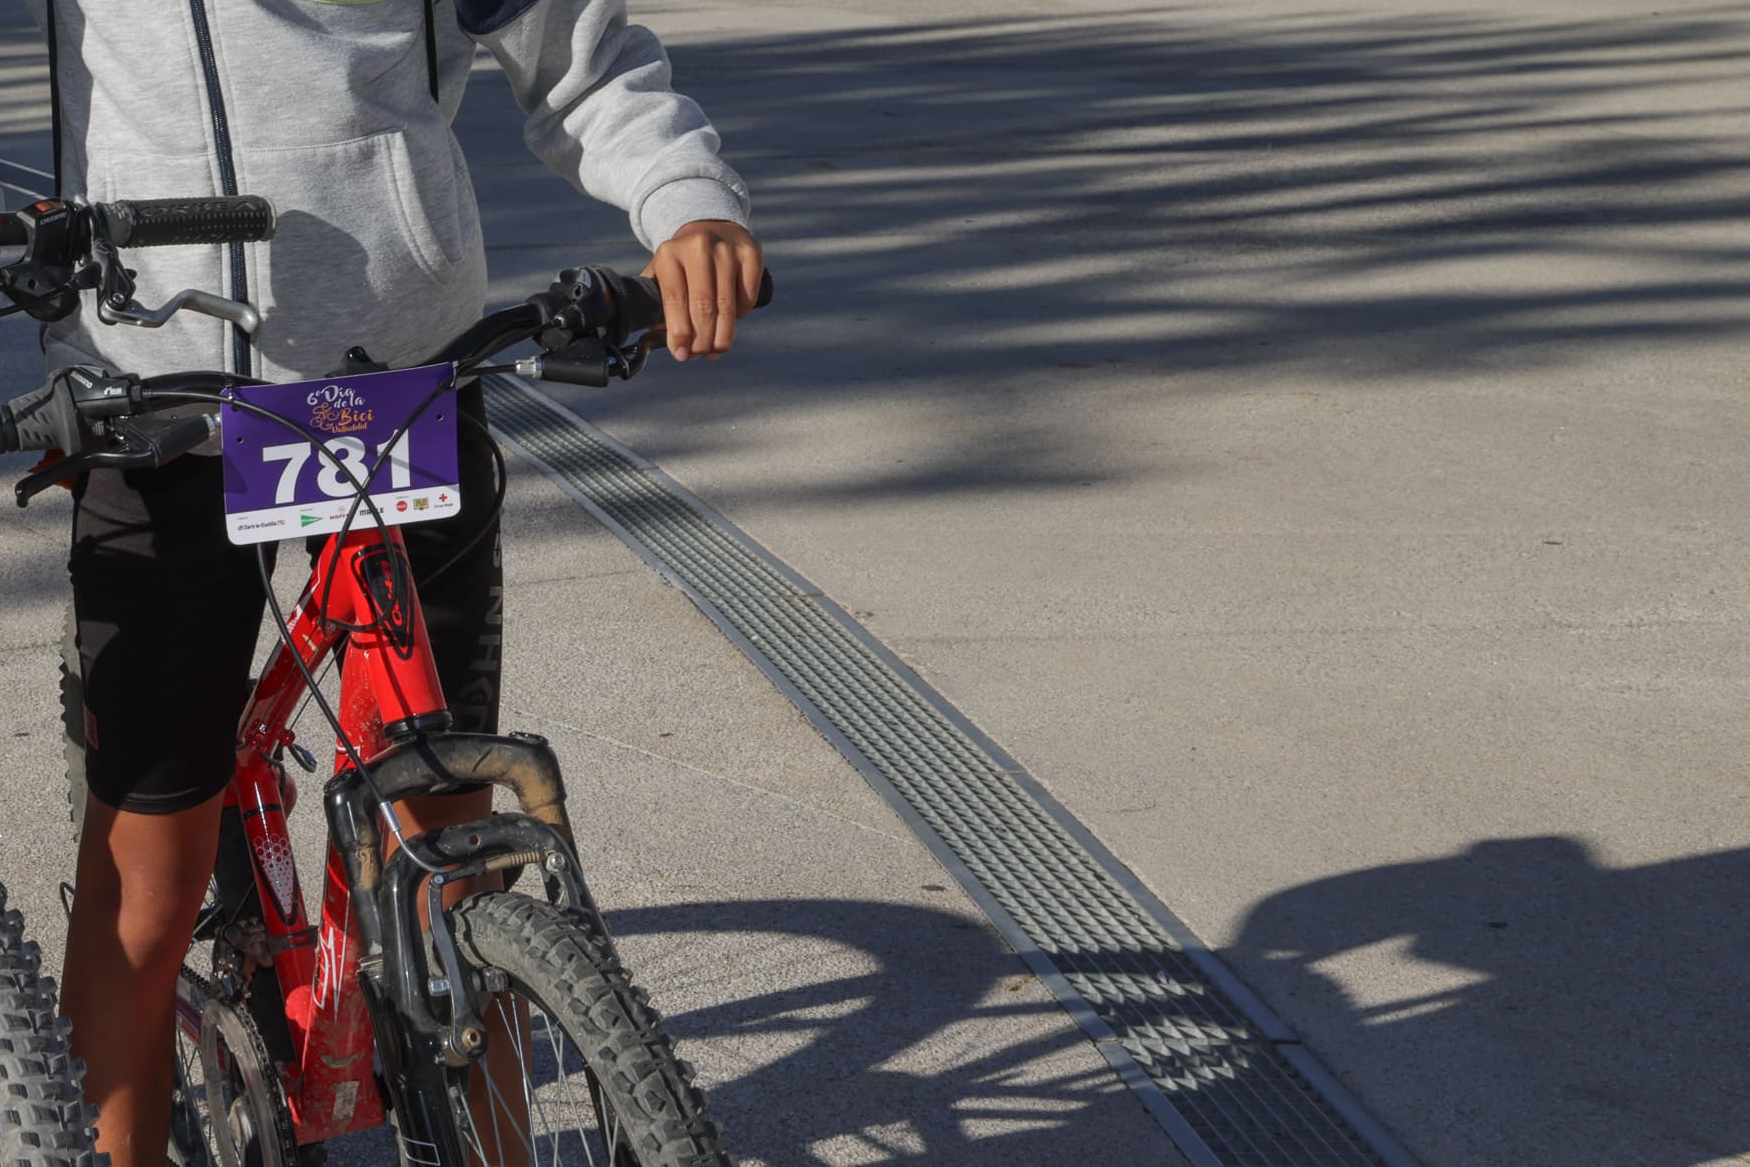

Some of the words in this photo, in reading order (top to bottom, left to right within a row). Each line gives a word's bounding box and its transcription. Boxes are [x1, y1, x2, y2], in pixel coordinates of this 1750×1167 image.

[333, 398, 347, 409] de
[337, 408, 374, 426] Bici
[263, 427, 411, 505] 781
